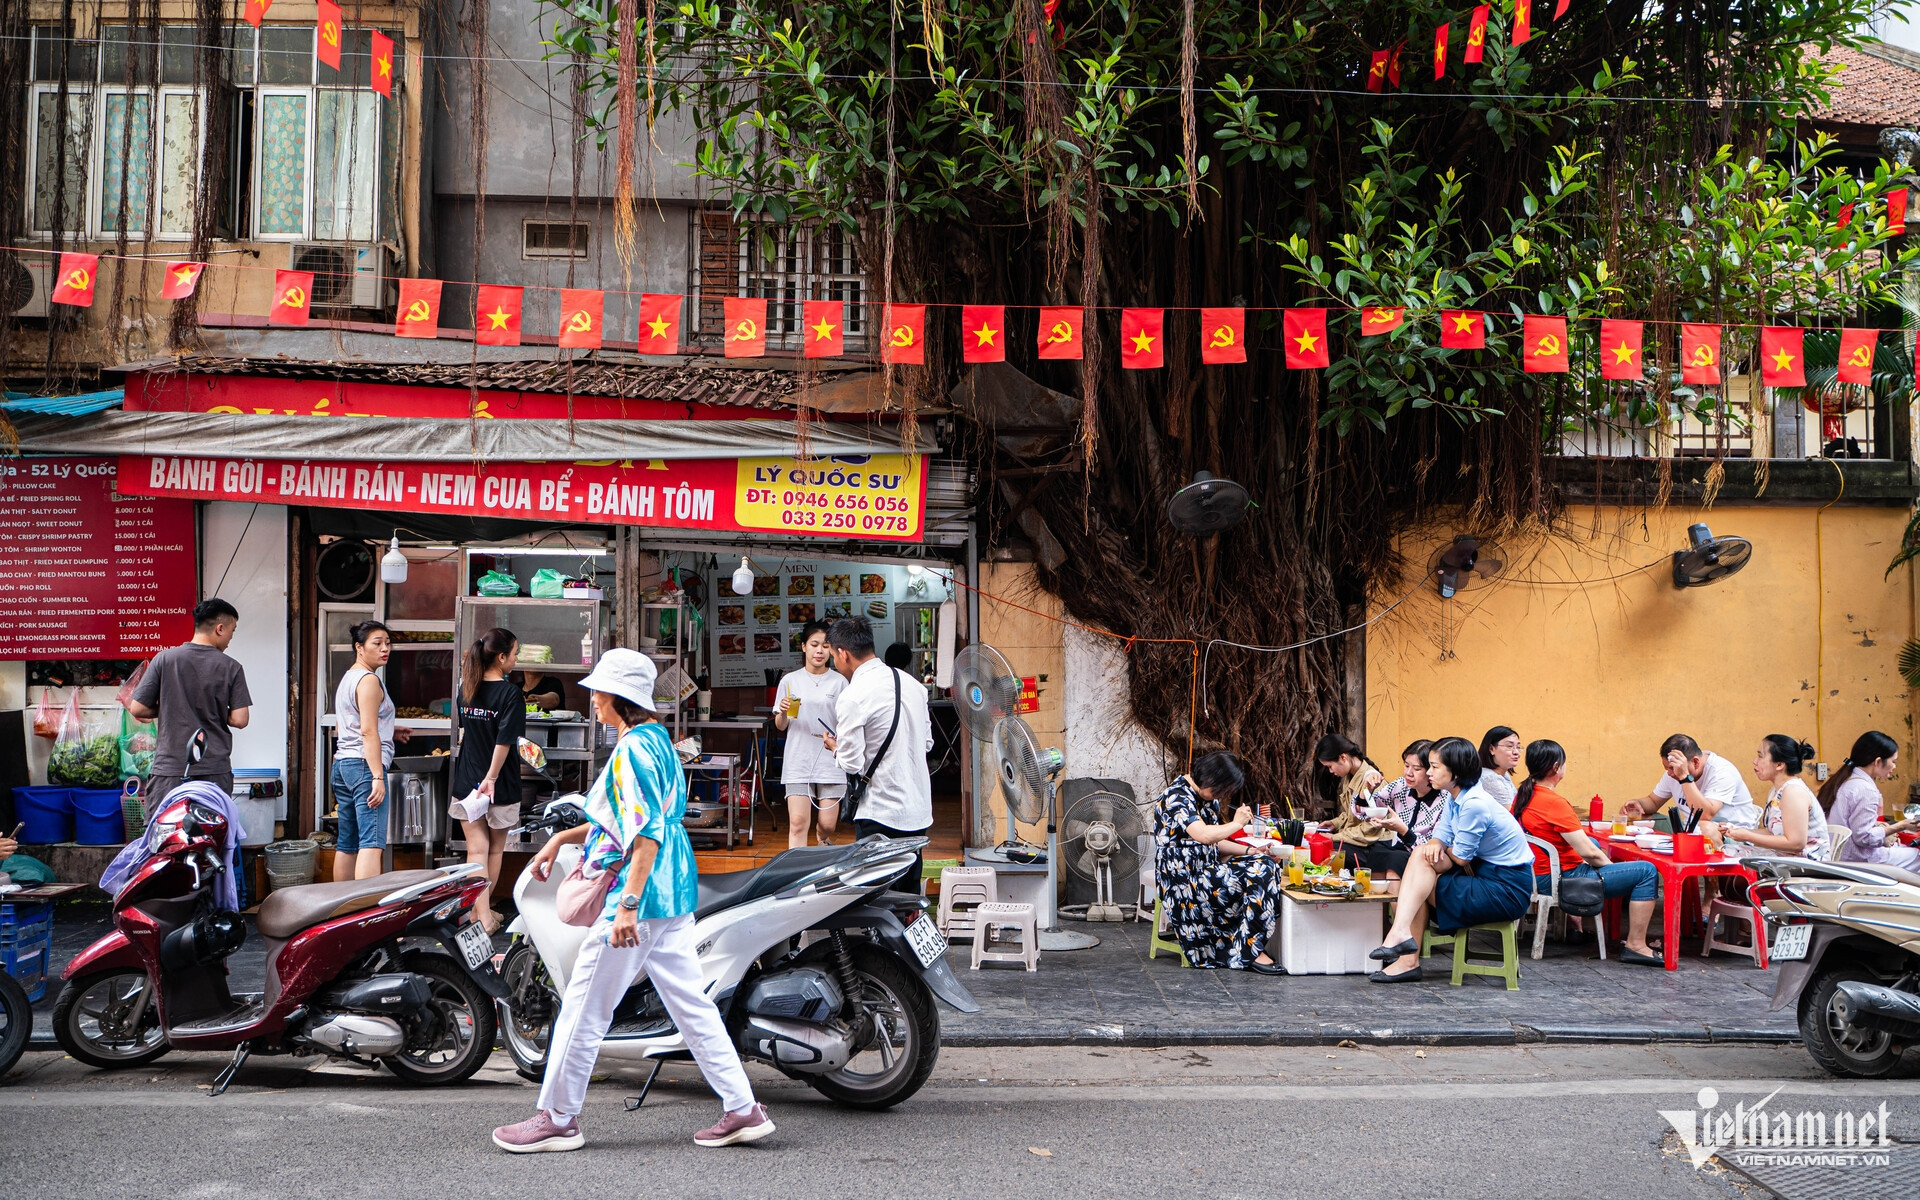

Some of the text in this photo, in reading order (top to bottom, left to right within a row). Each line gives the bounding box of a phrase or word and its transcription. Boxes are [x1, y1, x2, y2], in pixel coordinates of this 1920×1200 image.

[32, 464, 50, 476] 52
[54, 464, 71, 478] Lý
[75, 462, 117, 478] Quốc
[755, 464, 903, 490] LÝ QUỐC SƯ
[280, 460, 347, 498] BÁNH
[353, 463, 404, 502] RÁN
[420, 472, 476, 506] NEM
[484, 476, 532, 510] CUA
[539, 468, 574, 512] BỂ
[587, 477, 655, 518] BÁNH
[662, 481, 715, 521] TÔM
[746, 488, 909, 512] ĐT: 0946 656 056
[782, 510, 908, 532] 033 250 0978
[786, 564, 818, 574] MENU
[910, 917, 931, 946] 29-F1
[1780, 926, 1806, 942] 29-C1
[918, 932, 946, 964] 599.99
[1774, 942, 1806, 958] 929.79
